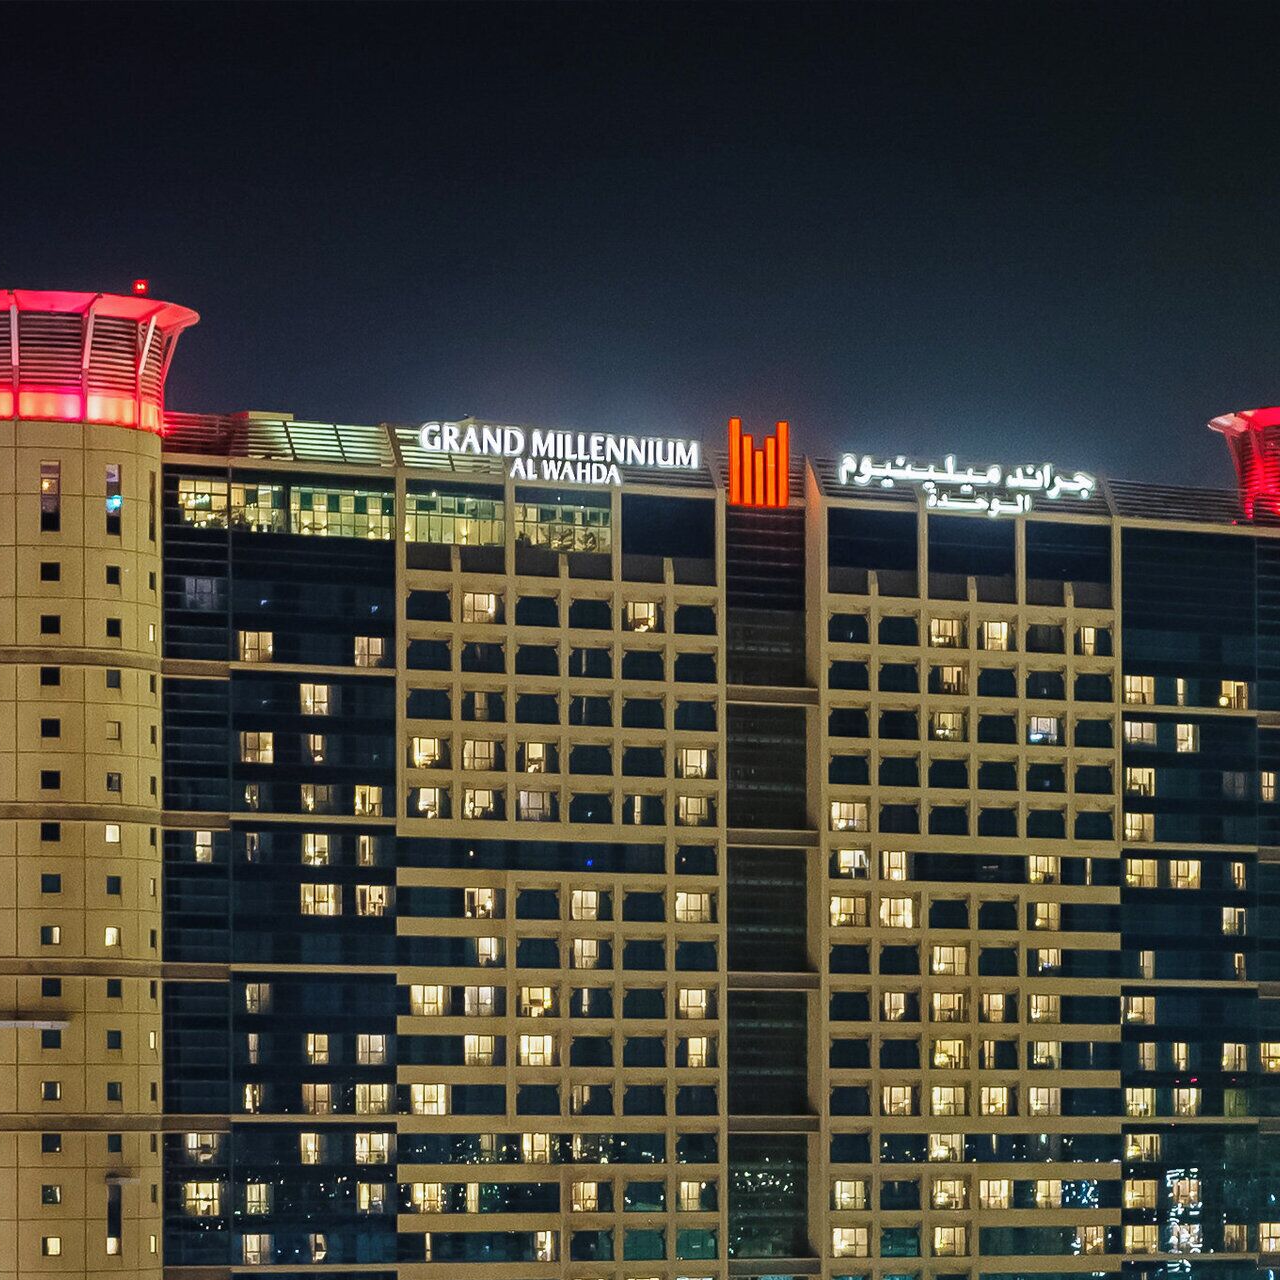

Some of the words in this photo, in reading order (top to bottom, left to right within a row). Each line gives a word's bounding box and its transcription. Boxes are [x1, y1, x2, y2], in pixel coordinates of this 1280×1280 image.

[420, 422, 525, 456] GRAND
[531, 429, 700, 469] MILLENNIUM
[510, 457, 538, 480] AL
[541, 460, 622, 485] WAHDA
[1006, 463, 1095, 499] جراند
[926, 487, 1032, 517] الوحدة
